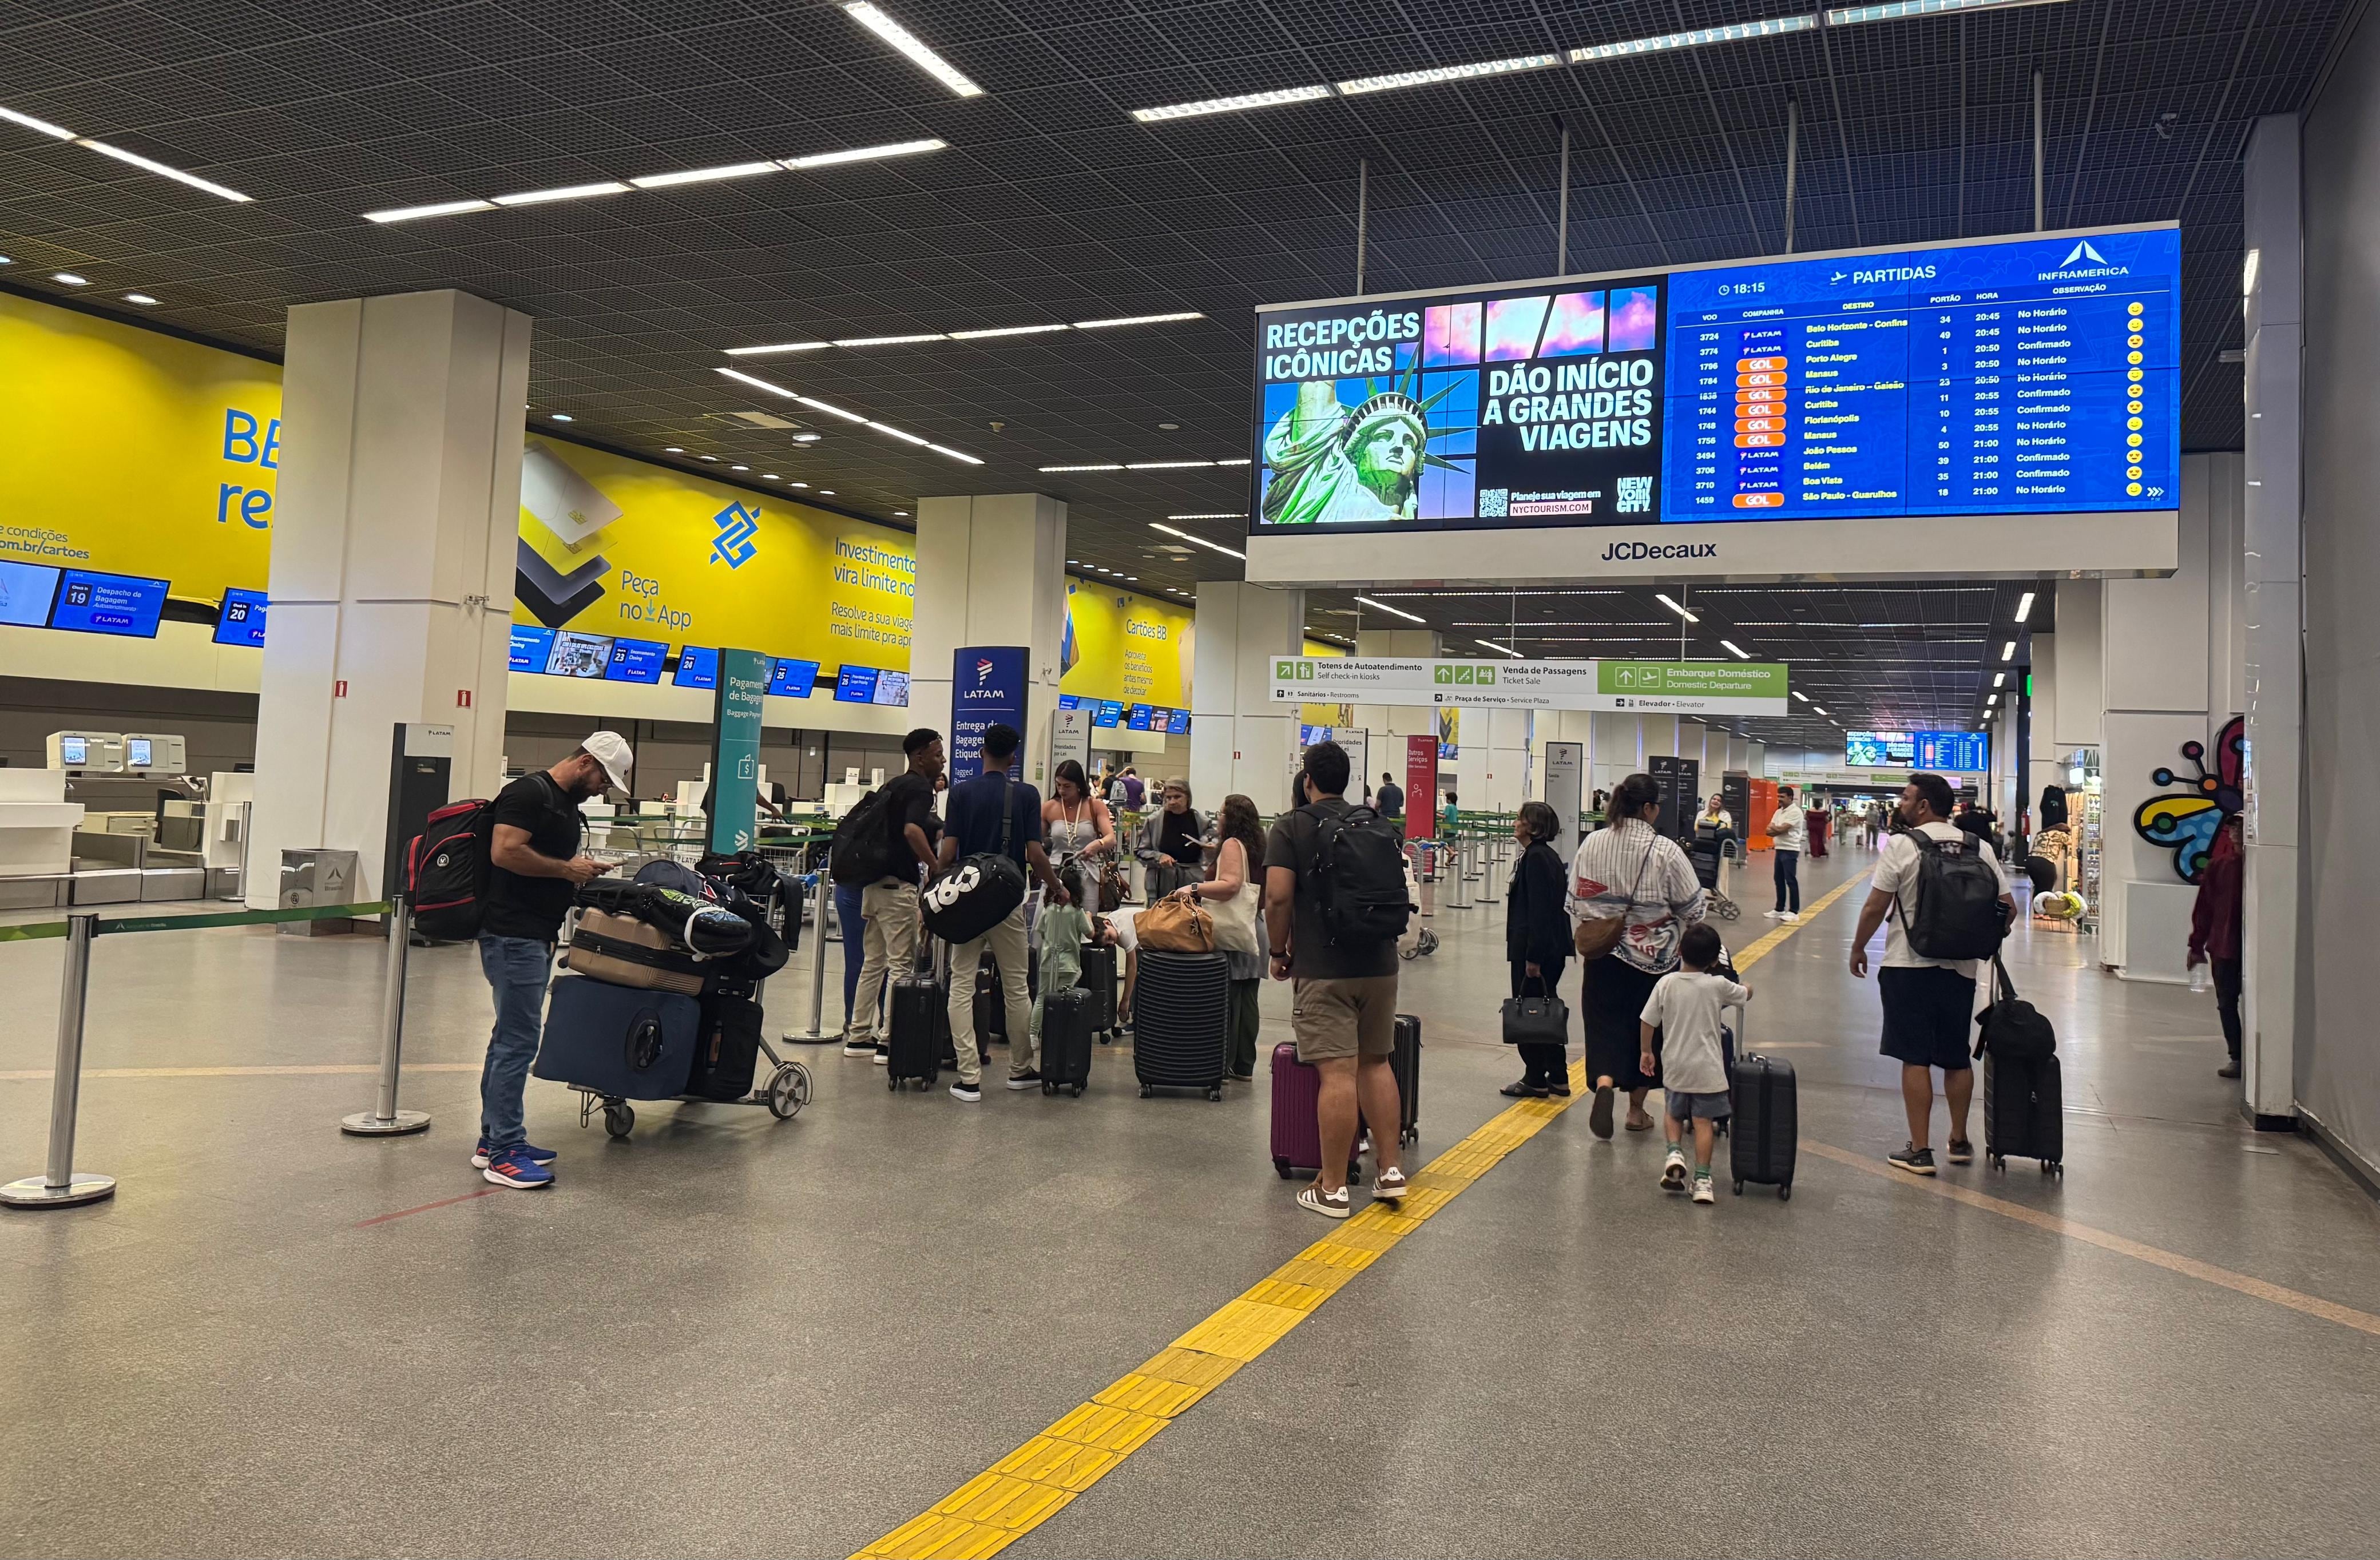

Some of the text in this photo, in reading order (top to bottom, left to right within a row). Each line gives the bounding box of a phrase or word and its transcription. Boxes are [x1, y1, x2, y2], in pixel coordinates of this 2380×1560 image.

[1853, 265, 1936, 284] PARTIDAS
[2038, 267, 2129, 281] INFRAMERICA
[1734, 283, 1764, 294] 18:15
[1743, 308, 1784, 318] COMPANHIA
[1842, 301, 1874, 311] DESTINO
[1930, 294, 1961, 303] PORTÃO
[2052, 284, 2107, 295] OBSERVAÇÃO
[1267, 308, 1420, 349] RECEPÇÕES
[1700, 333, 1719, 341] 3724
[1807, 325, 1826, 333] Belo
[1827, 322, 1867, 331] Horizonte
[1874, 319, 1908, 328] Confins
[1939, 316, 1951, 324] 34
[1976, 312, 2000, 321] 20:45
[2018, 310, 2031, 318] No
[2033, 308, 2067, 317] Horário
[1700, 348, 1718, 356] 3774
[1751, 346, 1782, 354] LATAM
[1806, 340, 1839, 348] Curitiba
[1975, 328, 2000, 336] 20:45
[2018, 326, 2031, 334] No
[2033, 324, 2067, 333] Horário
[1266, 346, 1392, 380] ICÔNICAS
[1489, 357, 1653, 397] DÃO INÍCIO
[1483, 388, 1652, 425] A GRANDES
[1520, 419, 1652, 451] VIAGENS
[1803, 447, 1824, 455] João
[1974, 439, 1999, 447] 21:00
[2017, 438, 2030, 446] No
[2032, 437, 2066, 445] Horário
[1617, 476, 1652, 490] NEW
[1511, 491, 1540, 501] Planeje
[1556, 491, 1588, 501] viagem
[1617, 489, 1651, 501] YORK
[1746, 495, 1770, 505] GOL
[1820, 492, 1846, 500] Paulo
[1851, 490, 1897, 499] Guarulhos
[1973, 487, 1998, 495] 21:00
[2031, 485, 2065, 493] Horário
[218, 483, 273, 529] re
[1512, 503, 1589, 514] NYCTOURISM.COM
[7, 527, 68, 542] condições
[1601, 542, 1717, 561] JCDecaux
[622, 570, 659, 598] Peça
[834, 563, 914, 597] vira limite no
[71, 592, 86, 604] 19
[97, 587, 131, 597] Despacho
[95, 596, 127, 605] Bagagem
[230, 609, 245, 620] 20
[620, 602, 691, 632] no App
[832, 602, 866, 621] Resolve
[868, 612, 873, 622] a
[876, 613, 890, 625] sua
[831, 622, 852, 637] mais
[855, 624, 880, 642] limite
[882, 632, 896, 645] pra
[1126, 619, 1167, 640] Cartões BB
[614, 653, 625, 661] 23
[1125, 649, 1147, 660] Aproveite
[683, 661, 692, 669] 24
[1130, 661, 1152, 673] benefícios
[1318, 662, 1422, 671] Totens de Autoatendimento
[1503, 666, 1586, 676] Venda de Passagens
[1124, 674, 1136, 682] antes
[1318, 672, 1330, 680] Self
[1359, 673, 1380, 681] kiosks
[1667, 669, 1771, 678] Embarque Doméstico
[1124, 686, 1129, 694] de
[1667, 680, 1752, 690] Domestic Departure
[729, 690, 739, 700] de
[964, 690, 1004, 699] LATAM
[1455, 695, 1471, 703] Praça
[1482, 696, 1506, 704] Serviço
[727, 709, 748, 719] Baggage
[957, 721, 985, 732] Entrega
[1408, 756, 1428, 764] Serviços
[955, 767, 973, 777] Tagged
